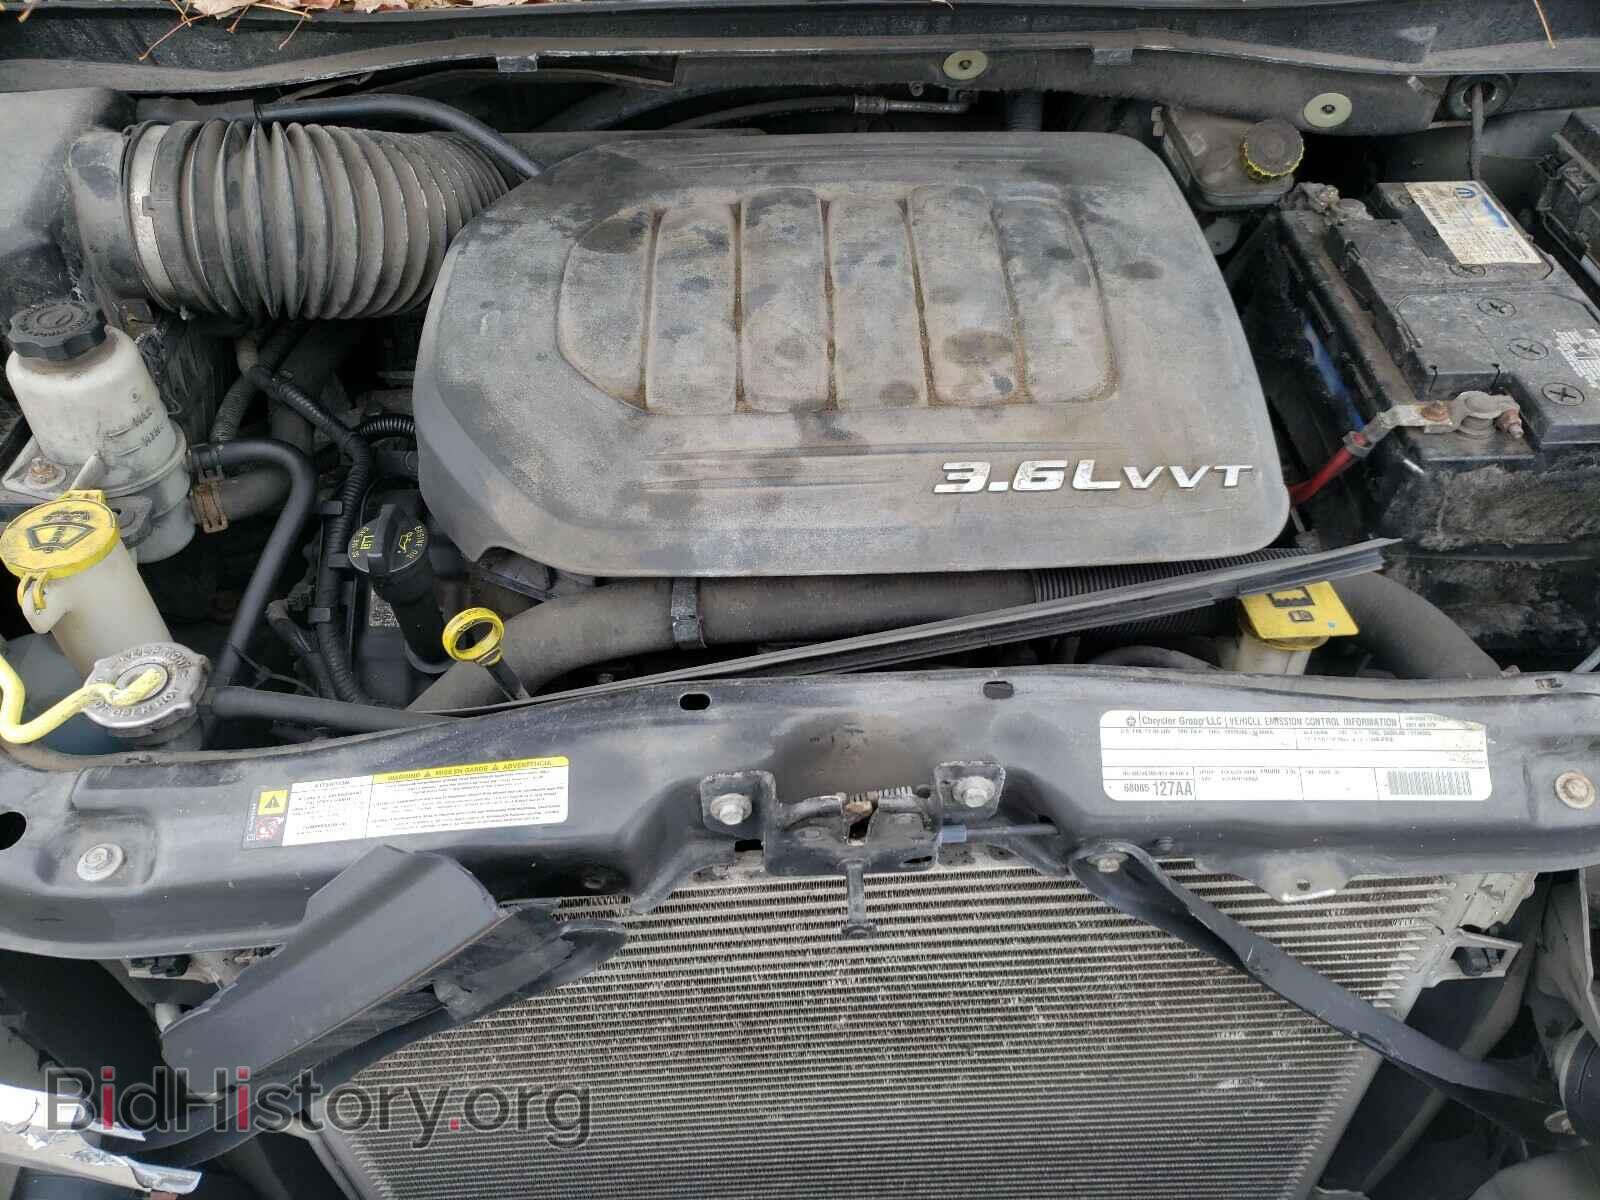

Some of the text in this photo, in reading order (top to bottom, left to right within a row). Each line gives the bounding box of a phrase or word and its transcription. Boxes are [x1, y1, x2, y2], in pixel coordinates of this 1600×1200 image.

[933, 459, 1253, 494] 3.6L VVT
[1141, 716, 1176, 727] Chrysler
[1178, 716, 1204, 728] Group
[1206, 716, 1222, 726] LLC
[1228, 716, 1262, 727] VEHICLE
[1264, 716, 1302, 727] EMISSION
[1304, 716, 1340, 727] CONTROL
[1343, 717, 1397, 728] INFORMATION
[1153, 781, 1193, 796] 127AA
